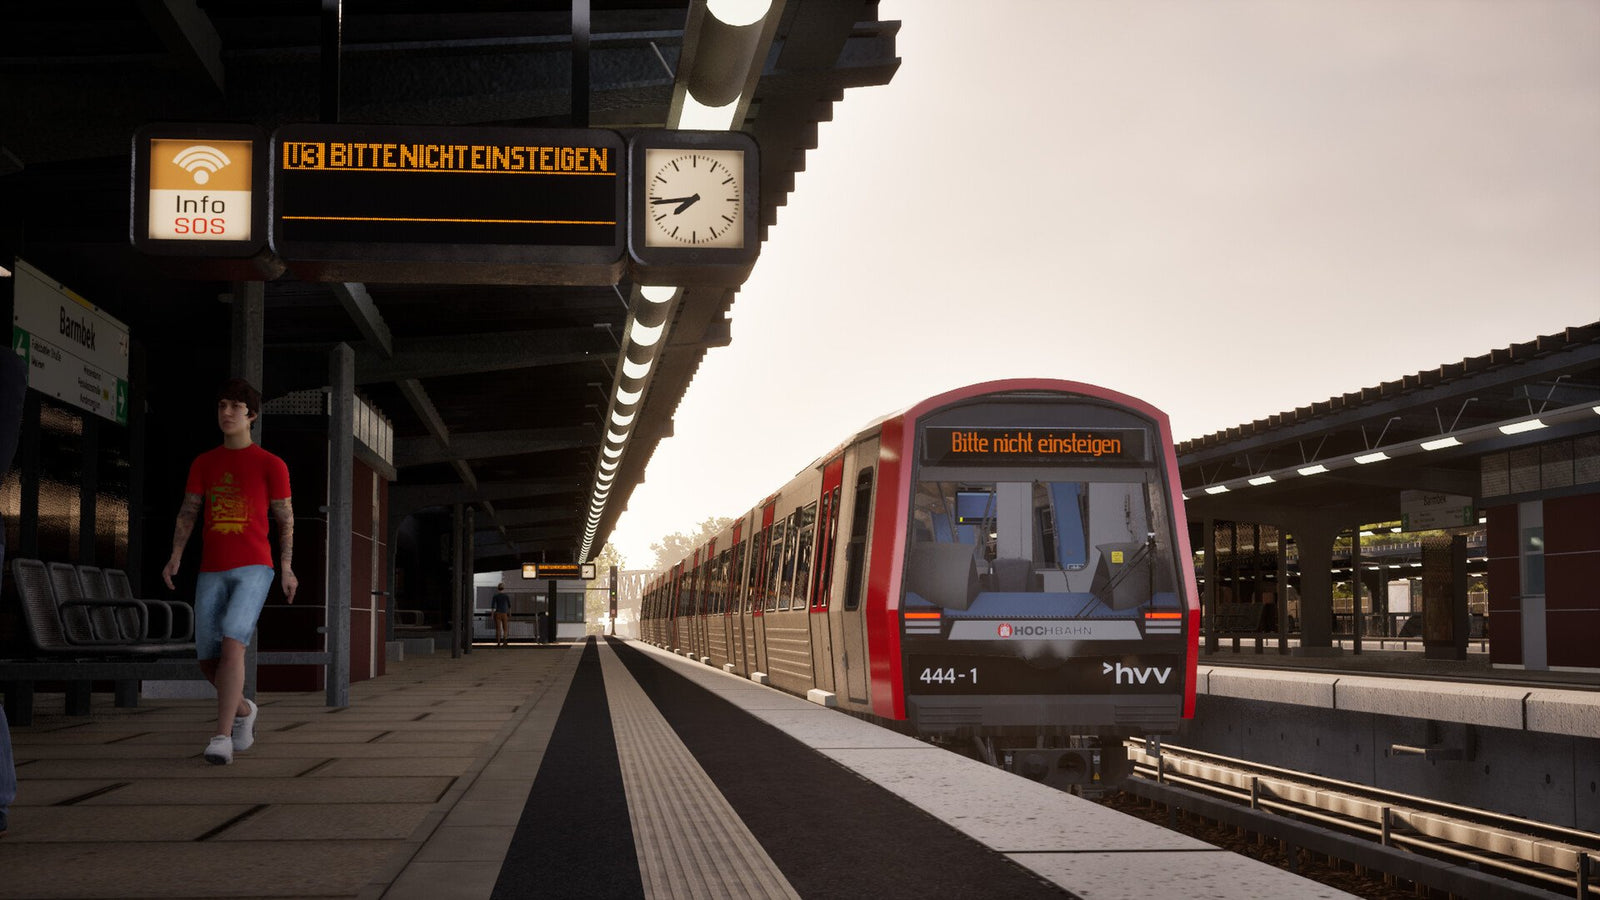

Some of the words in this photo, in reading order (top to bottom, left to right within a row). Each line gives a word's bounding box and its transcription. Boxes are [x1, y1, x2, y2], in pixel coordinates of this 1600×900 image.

[285, 142, 323, 169] U3
[330, 142, 397, 168] BITTE
[176, 194, 225, 214] Info
[174, 217, 225, 235] SOS
[59, 305, 96, 351] Barmbek
[952, 431, 989, 453] Bitte
[993, 431, 1033, 454] nicht
[1037, 432, 1121, 457] einsteigen
[1014, 625, 1092, 636] HOCHBAHN
[919, 667, 978, 684] 444-1
